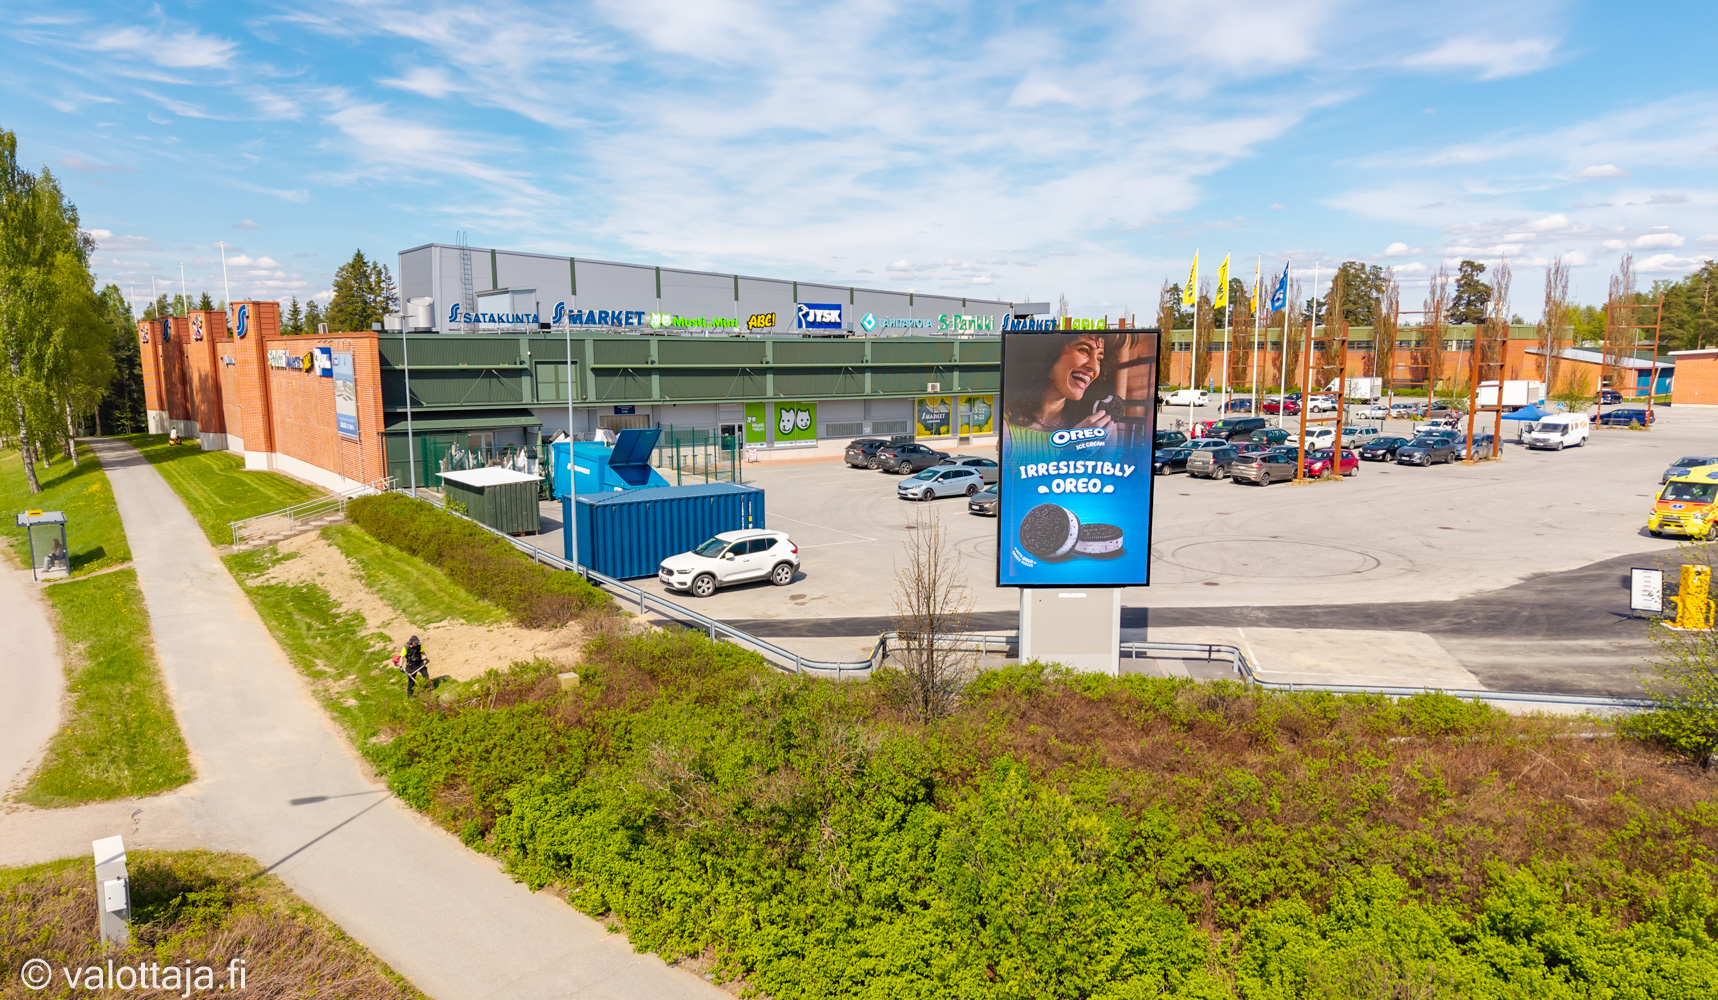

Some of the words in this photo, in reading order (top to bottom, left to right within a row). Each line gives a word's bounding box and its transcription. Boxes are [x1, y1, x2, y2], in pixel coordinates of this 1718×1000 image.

[463, 312, 540, 324] SATAKUNTA
[567, 309, 646, 326] MARKET
[673, 316, 706, 328] Musti
[747, 312, 777, 330] ABC!
[806, 309, 841, 323] JYSK
[938, 313, 995, 331] S-Pankki
[1010, 318, 1057, 331] MARKET
[1052, 428, 1106, 445] OREO
[1019, 460, 1136, 479] IRRESISTIBLY
[1051, 477, 1102, 494] OREO
